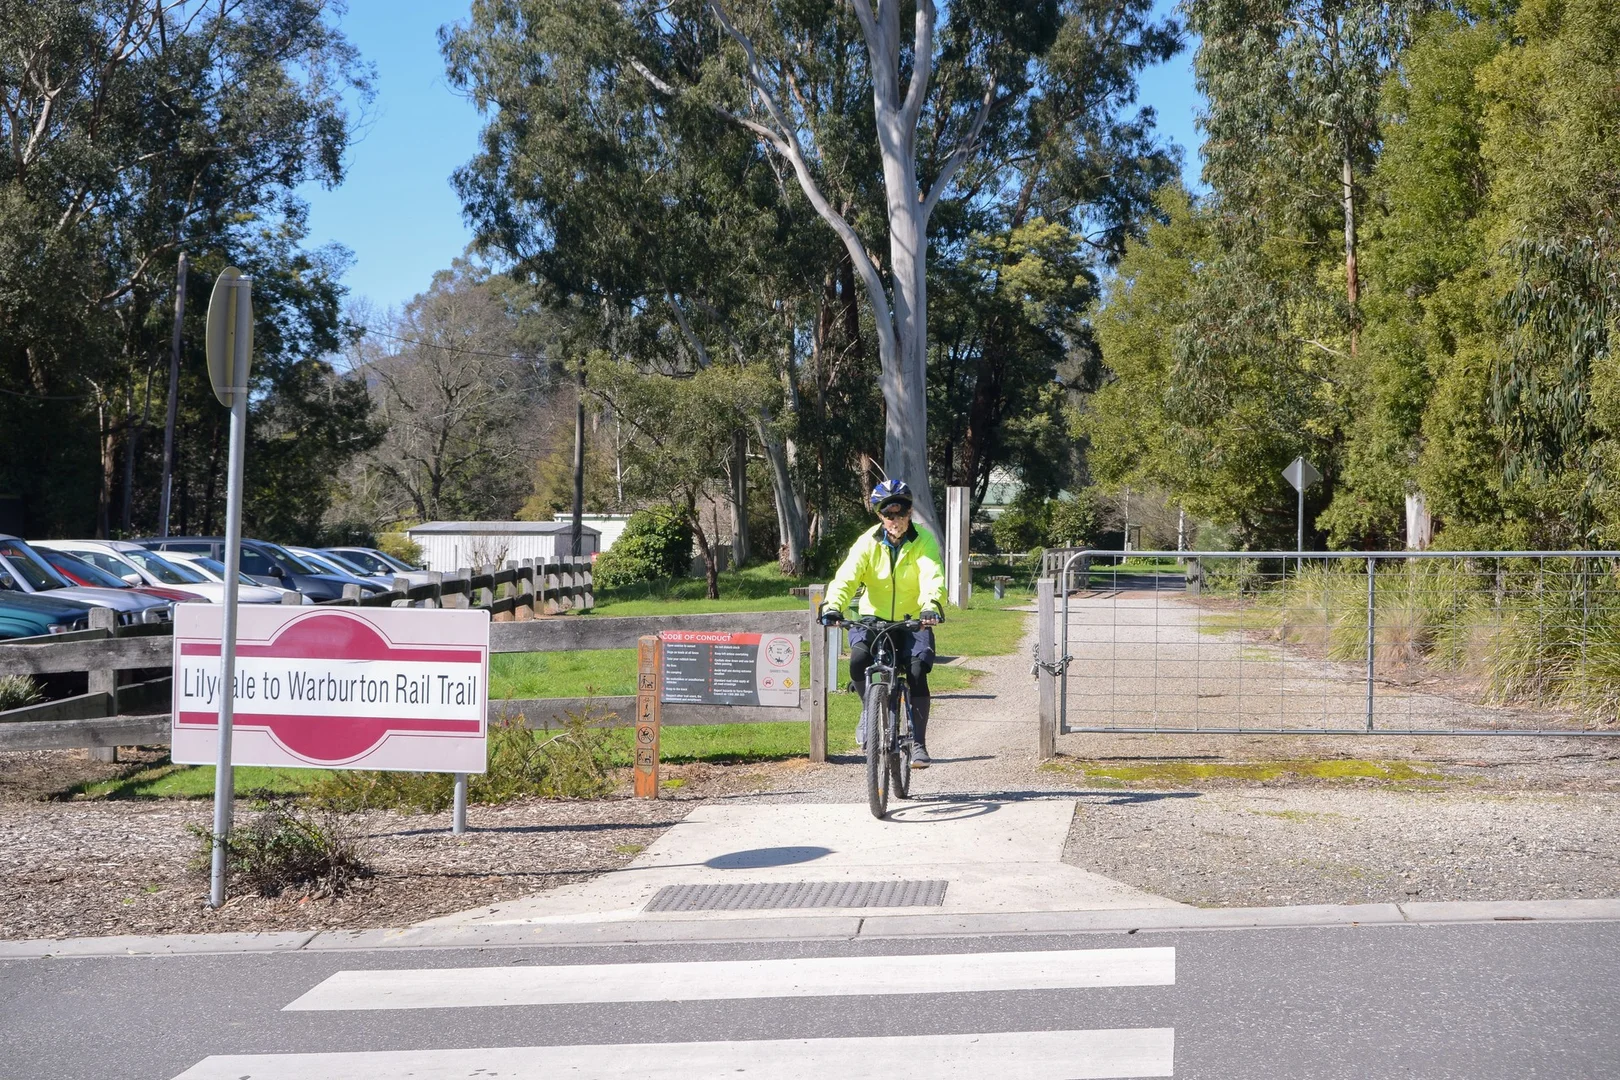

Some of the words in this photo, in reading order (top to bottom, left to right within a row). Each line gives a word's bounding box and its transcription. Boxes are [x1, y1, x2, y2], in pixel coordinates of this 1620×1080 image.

[184, 668, 256, 704] Lilyale
[263, 672, 280, 700] to
[288, 670, 389, 703] Warburton
[395, 673, 430, 706] Rail
[437, 674, 477, 706] Trail
